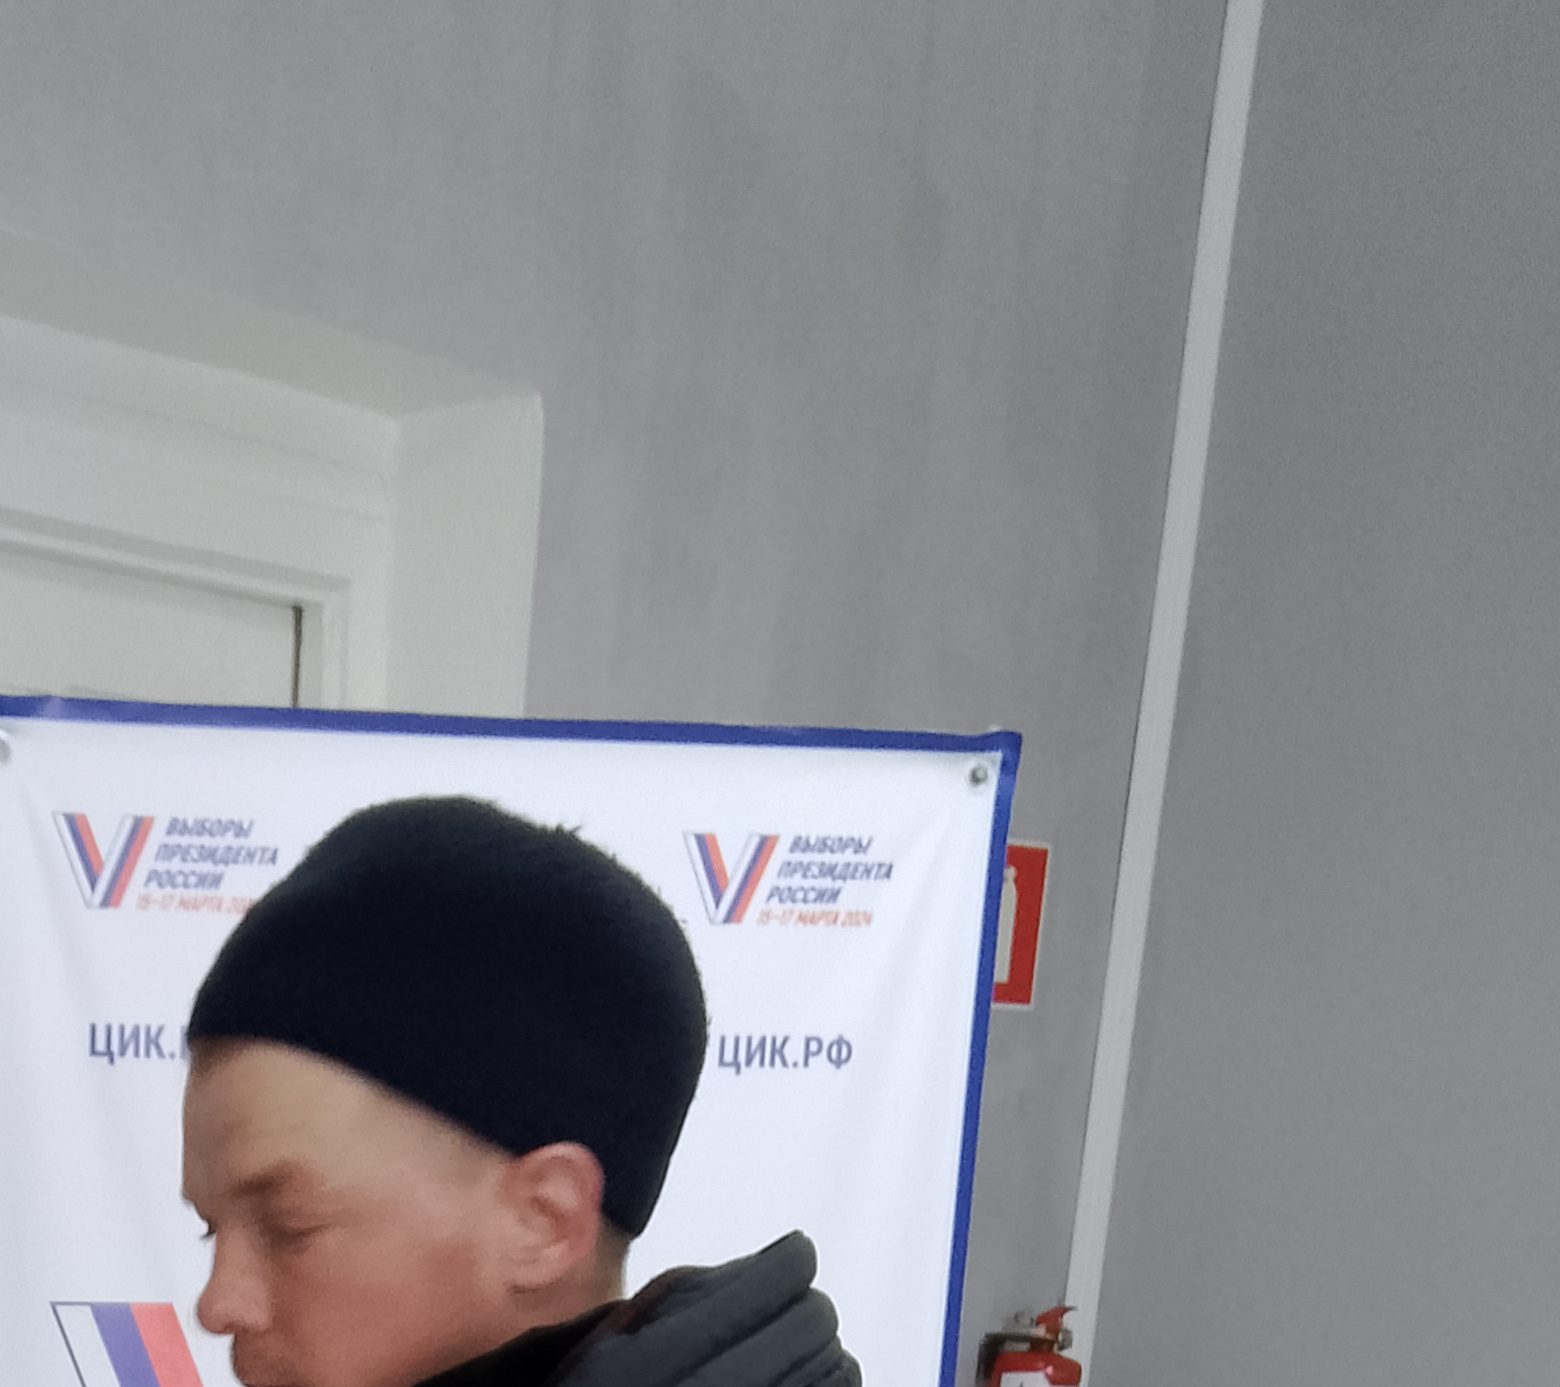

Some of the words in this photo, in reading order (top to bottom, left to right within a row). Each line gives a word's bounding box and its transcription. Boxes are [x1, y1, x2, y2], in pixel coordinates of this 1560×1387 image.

[166, 816, 254, 839] ВЫБОРЫ
[154, 843, 279, 867] ПРЕЗИДЕНТА
[788, 835, 873, 855] ВЫБОРЫ
[143, 869, 225, 890] РОССИИ
[777, 860, 894, 882] ПРЕЗИДЕНТА
[766, 886, 843, 905] РОССИИ
[717, 1034, 853, 1075] ЦИК.РФ
